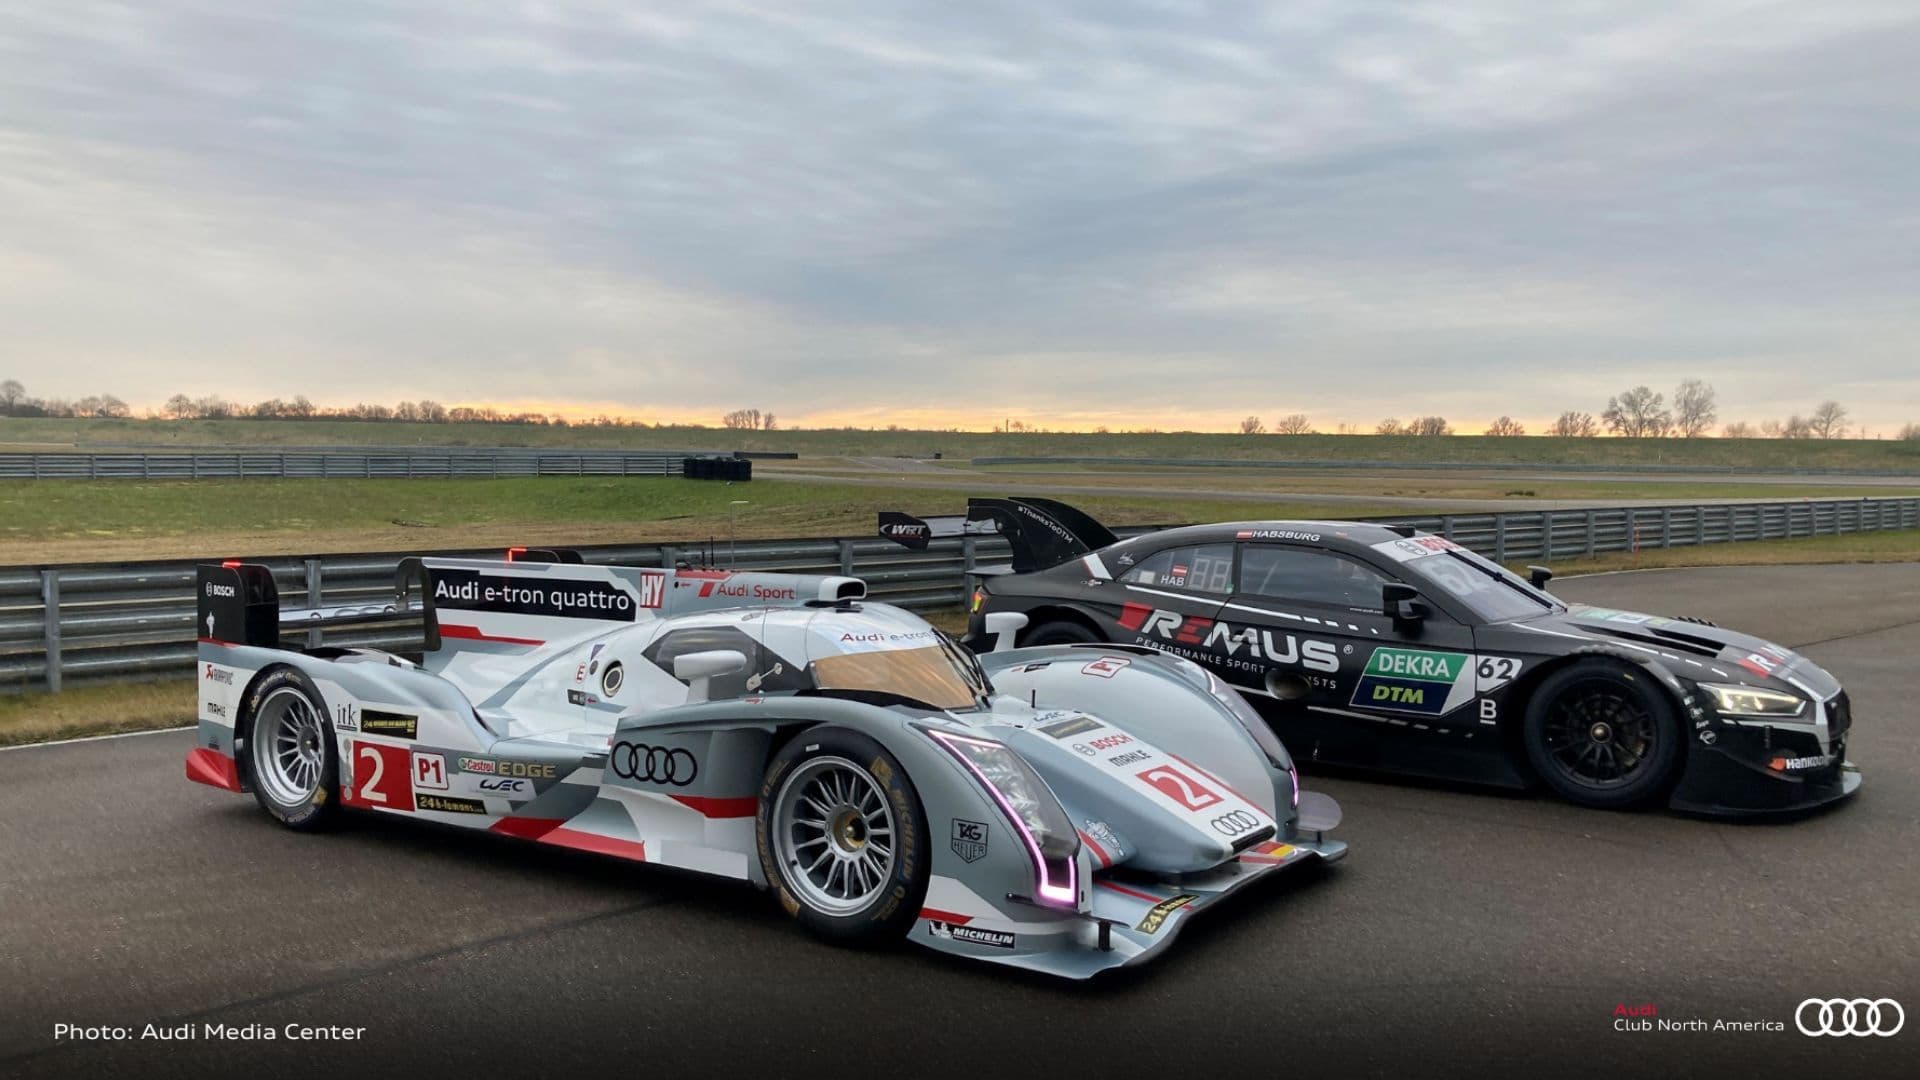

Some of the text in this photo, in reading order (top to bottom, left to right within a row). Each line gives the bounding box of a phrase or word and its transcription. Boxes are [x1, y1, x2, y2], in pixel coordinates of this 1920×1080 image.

[891, 525, 925, 535] WRT
[1252, 530, 1320, 542] HABSBURG
[1160, 575, 1184, 587] HAB
[213, 585, 234, 597] BOSCH
[435, 579, 630, 611] Audi e-tron quattro
[641, 575, 665, 607] HY
[717, 584, 795, 601] Audi Sport
[841, 633, 885, 641] Audi
[1135, 636, 1265, 674] PERFORMANCE SPORT
[1378, 652, 1450, 678] DEKRA
[1478, 658, 1514, 680] 62
[1372, 685, 1424, 704] DTM
[337, 703, 357, 726] itk
[1089, 734, 1134, 750] BOSCH
[418, 757, 442, 784] P1
[467, 760, 557, 778] Castrol EDGE
[1786, 756, 1830, 769] Hankoo
[360, 747, 387, 802] 2
[480, 779, 524, 792] WEC
[1147, 771, 1215, 806] 2
[958, 823, 982, 840] TAG
[953, 840, 985, 860] HEUER
[952, 928, 1014, 944] MICHELIN
